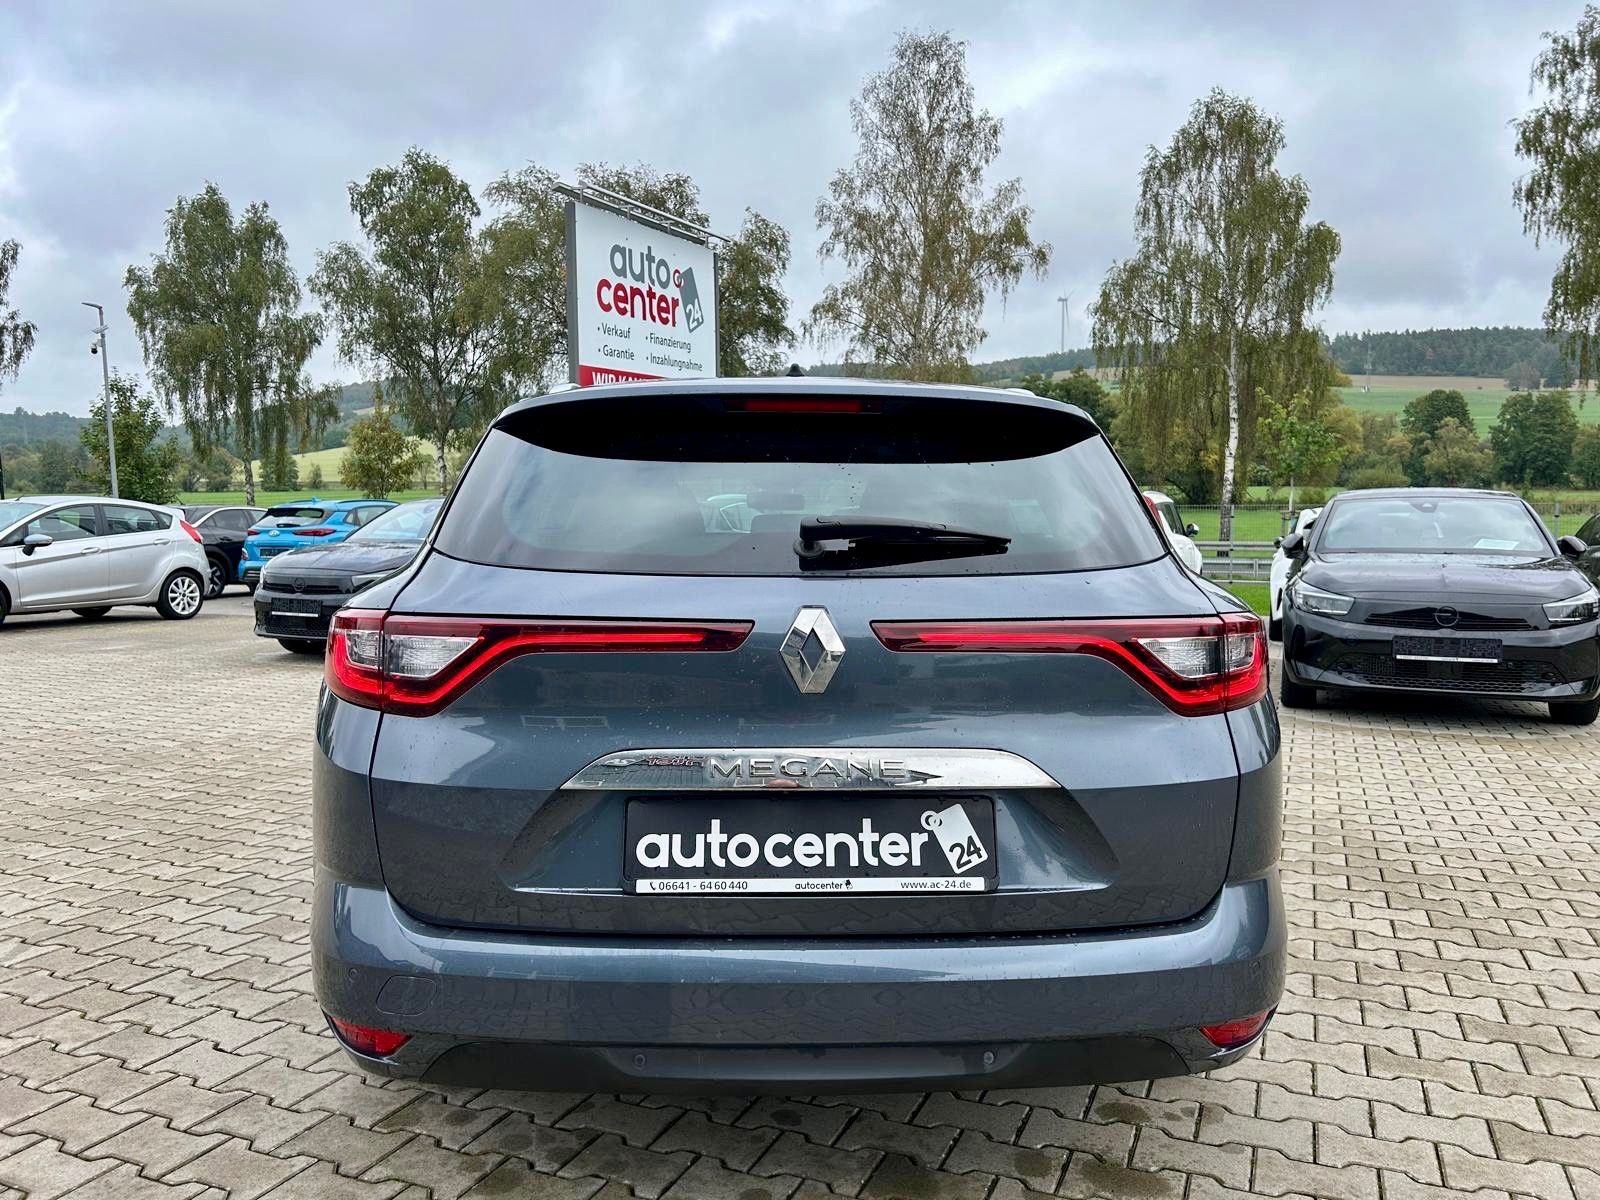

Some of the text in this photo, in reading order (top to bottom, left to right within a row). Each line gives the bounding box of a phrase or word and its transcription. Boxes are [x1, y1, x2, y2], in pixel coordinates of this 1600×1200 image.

[609, 243, 671, 290] auto
[596, 278, 680, 327] center
[686, 299, 701, 330] 24
[602, 323, 631, 340] Verkauf
[602, 344, 635, 361] Garantie
[649, 333, 691, 354] Finanzierung
[650, 352, 703, 372] Inzahlungnahme
[710, 757, 906, 778] MEGANE
[635, 818, 983, 870] autocenter 24
[658, 881, 690, 891] 06641
[794, 880, 843, 890] autocenter
[900, 880, 972, 889] www.ac-24.de
